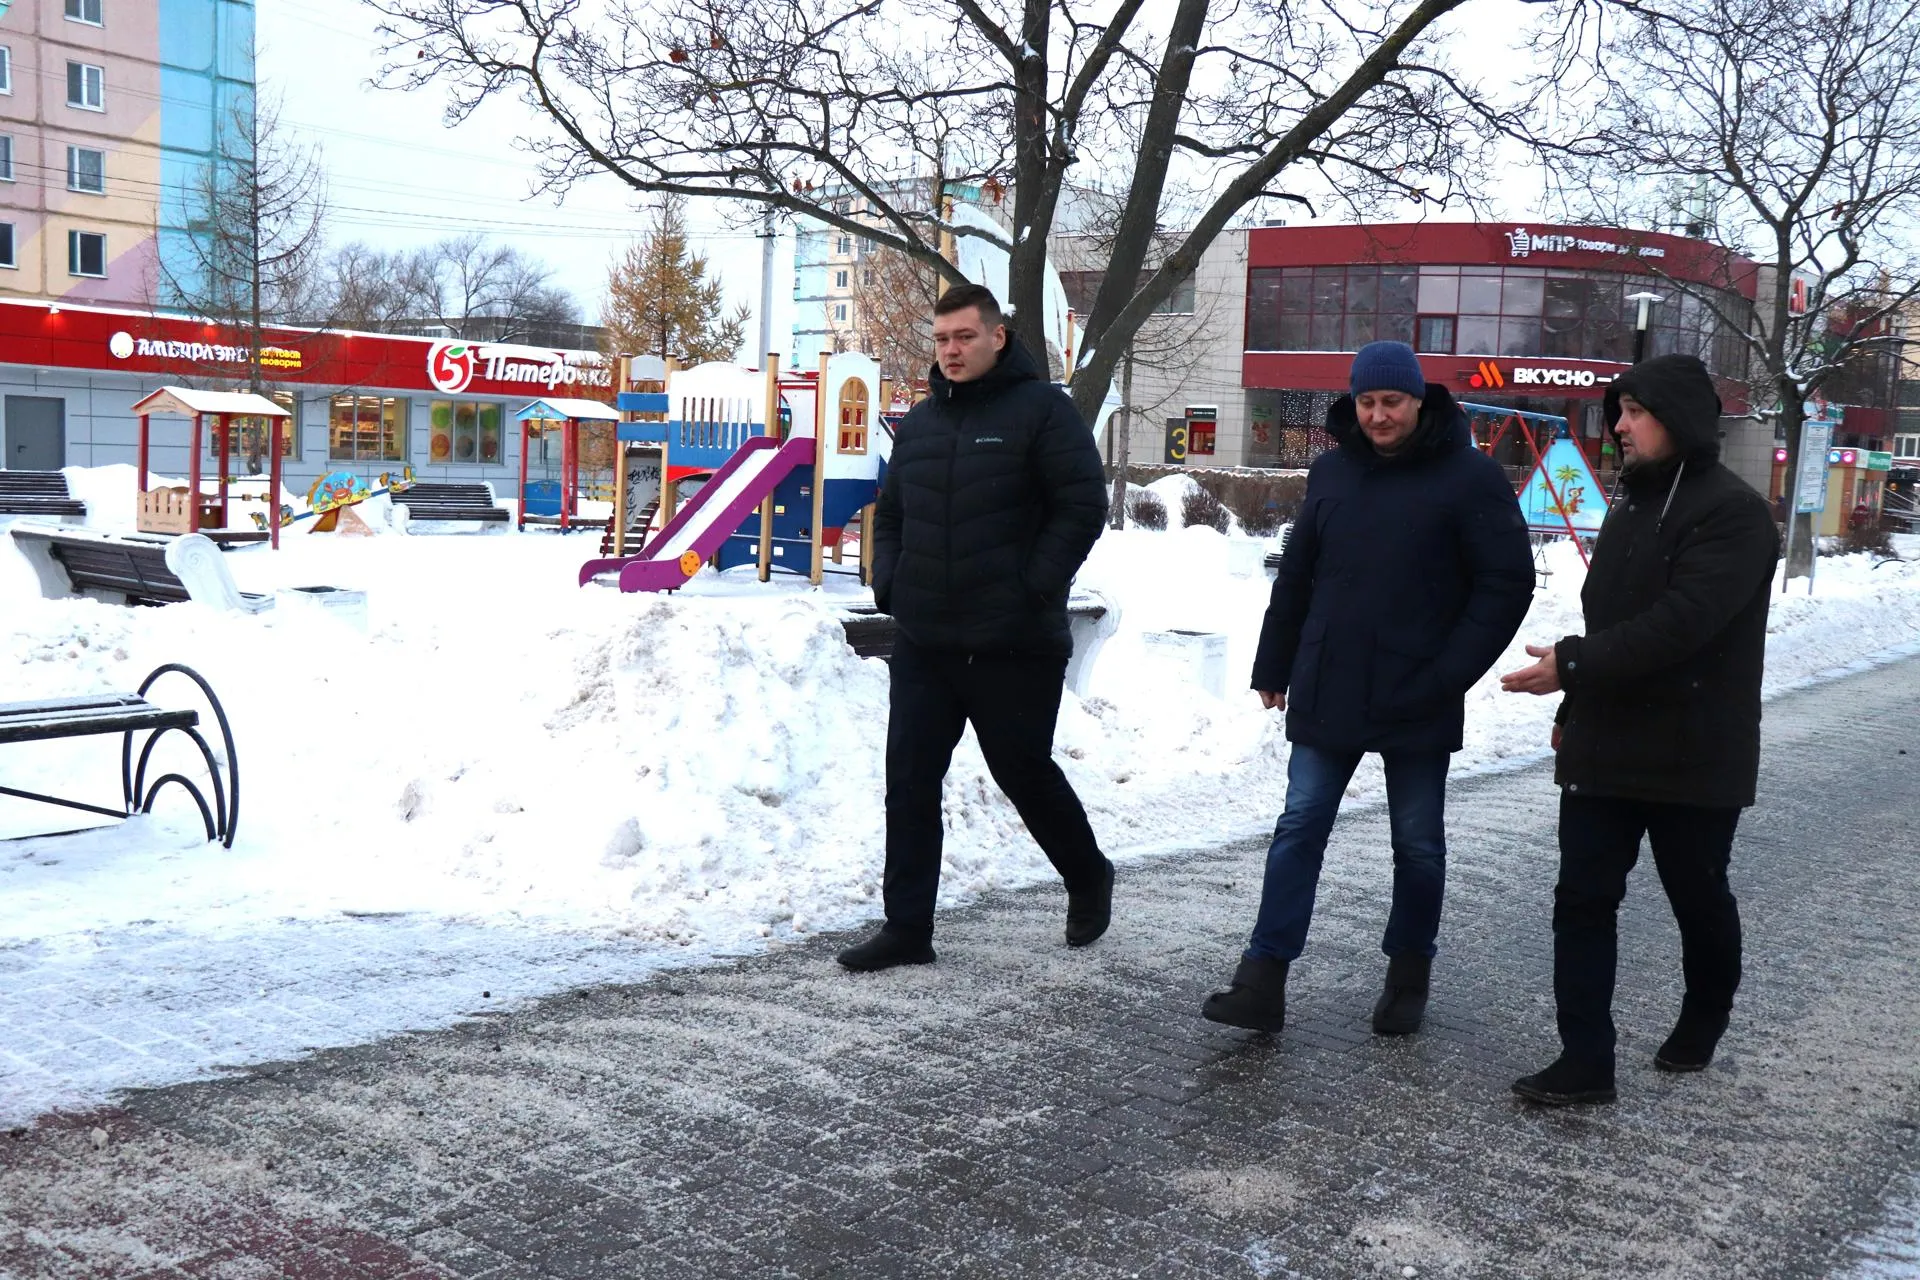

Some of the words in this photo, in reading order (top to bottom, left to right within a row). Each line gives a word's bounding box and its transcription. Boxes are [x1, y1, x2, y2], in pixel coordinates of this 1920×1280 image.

[1532, 234, 1575, 252] МПР
[1513, 367, 1595, 387] ВКУСНО
[1170, 427, 1186, 459] 3
